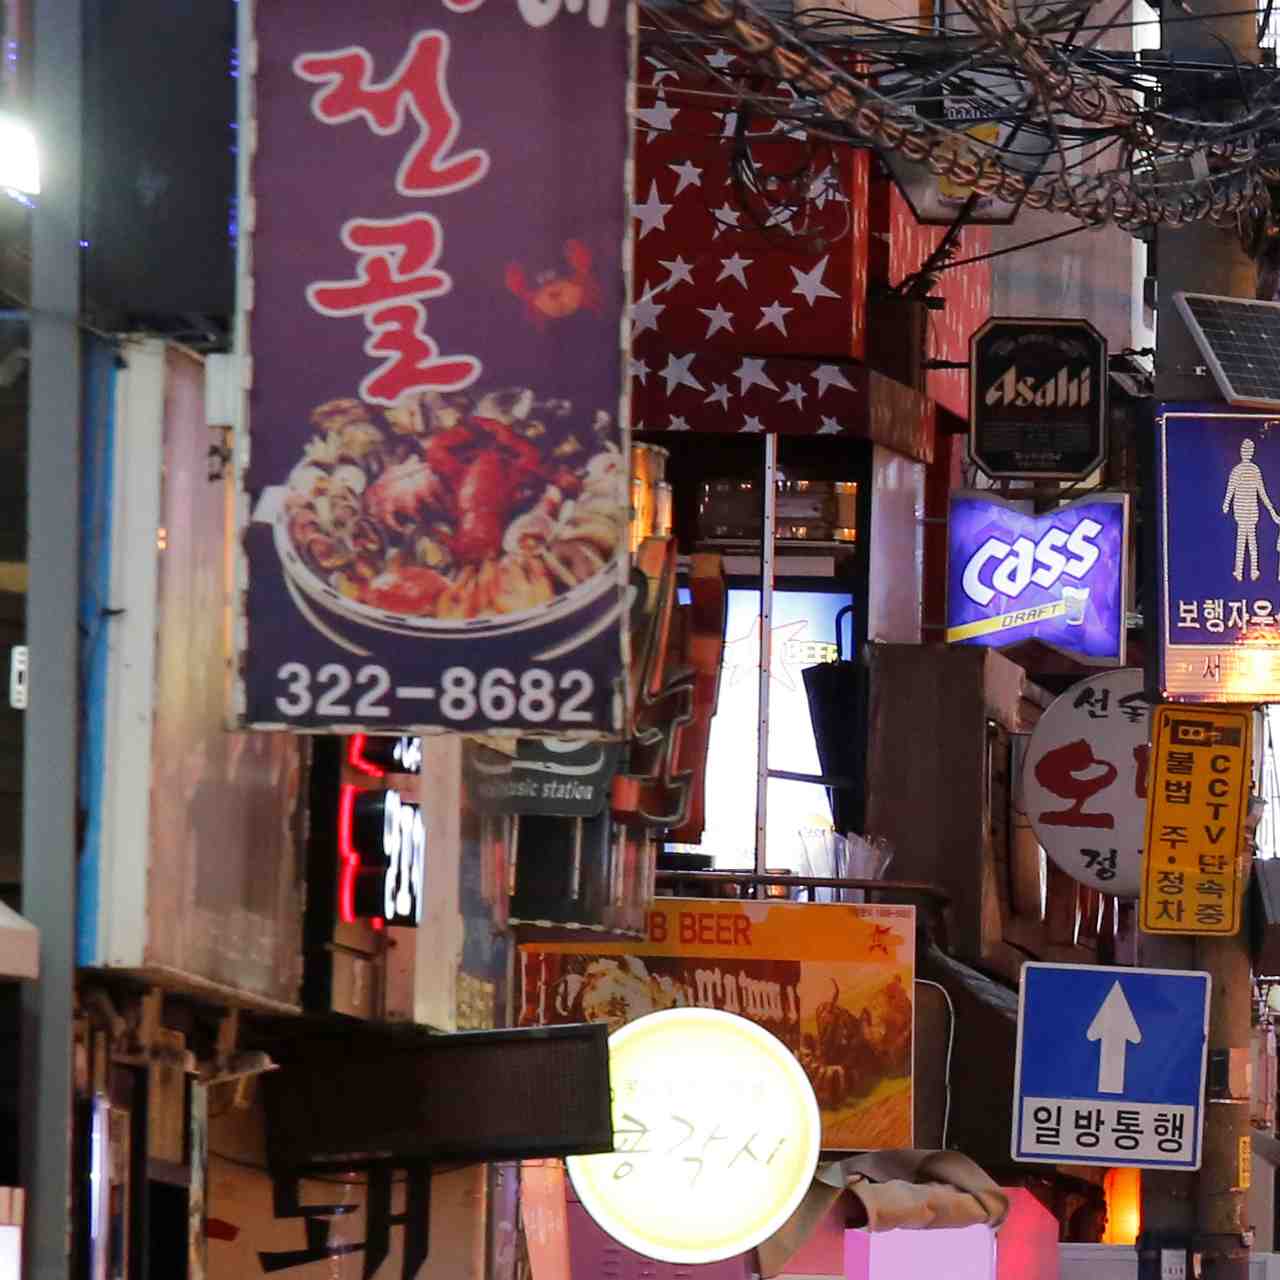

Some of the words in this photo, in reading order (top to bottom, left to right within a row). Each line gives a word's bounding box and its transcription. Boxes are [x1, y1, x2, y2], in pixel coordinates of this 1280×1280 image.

[986, 366, 1090, 407] Asahi
[1001, 604, 1058, 629] DRAFT
[275, 663, 593, 719] 322-8682
[542, 779, 594, 801] station
[1203, 754, 1232, 844] CCTV
[679, 912, 752, 945] BEER
[1033, 1103, 1186, 1154] 일방통행
